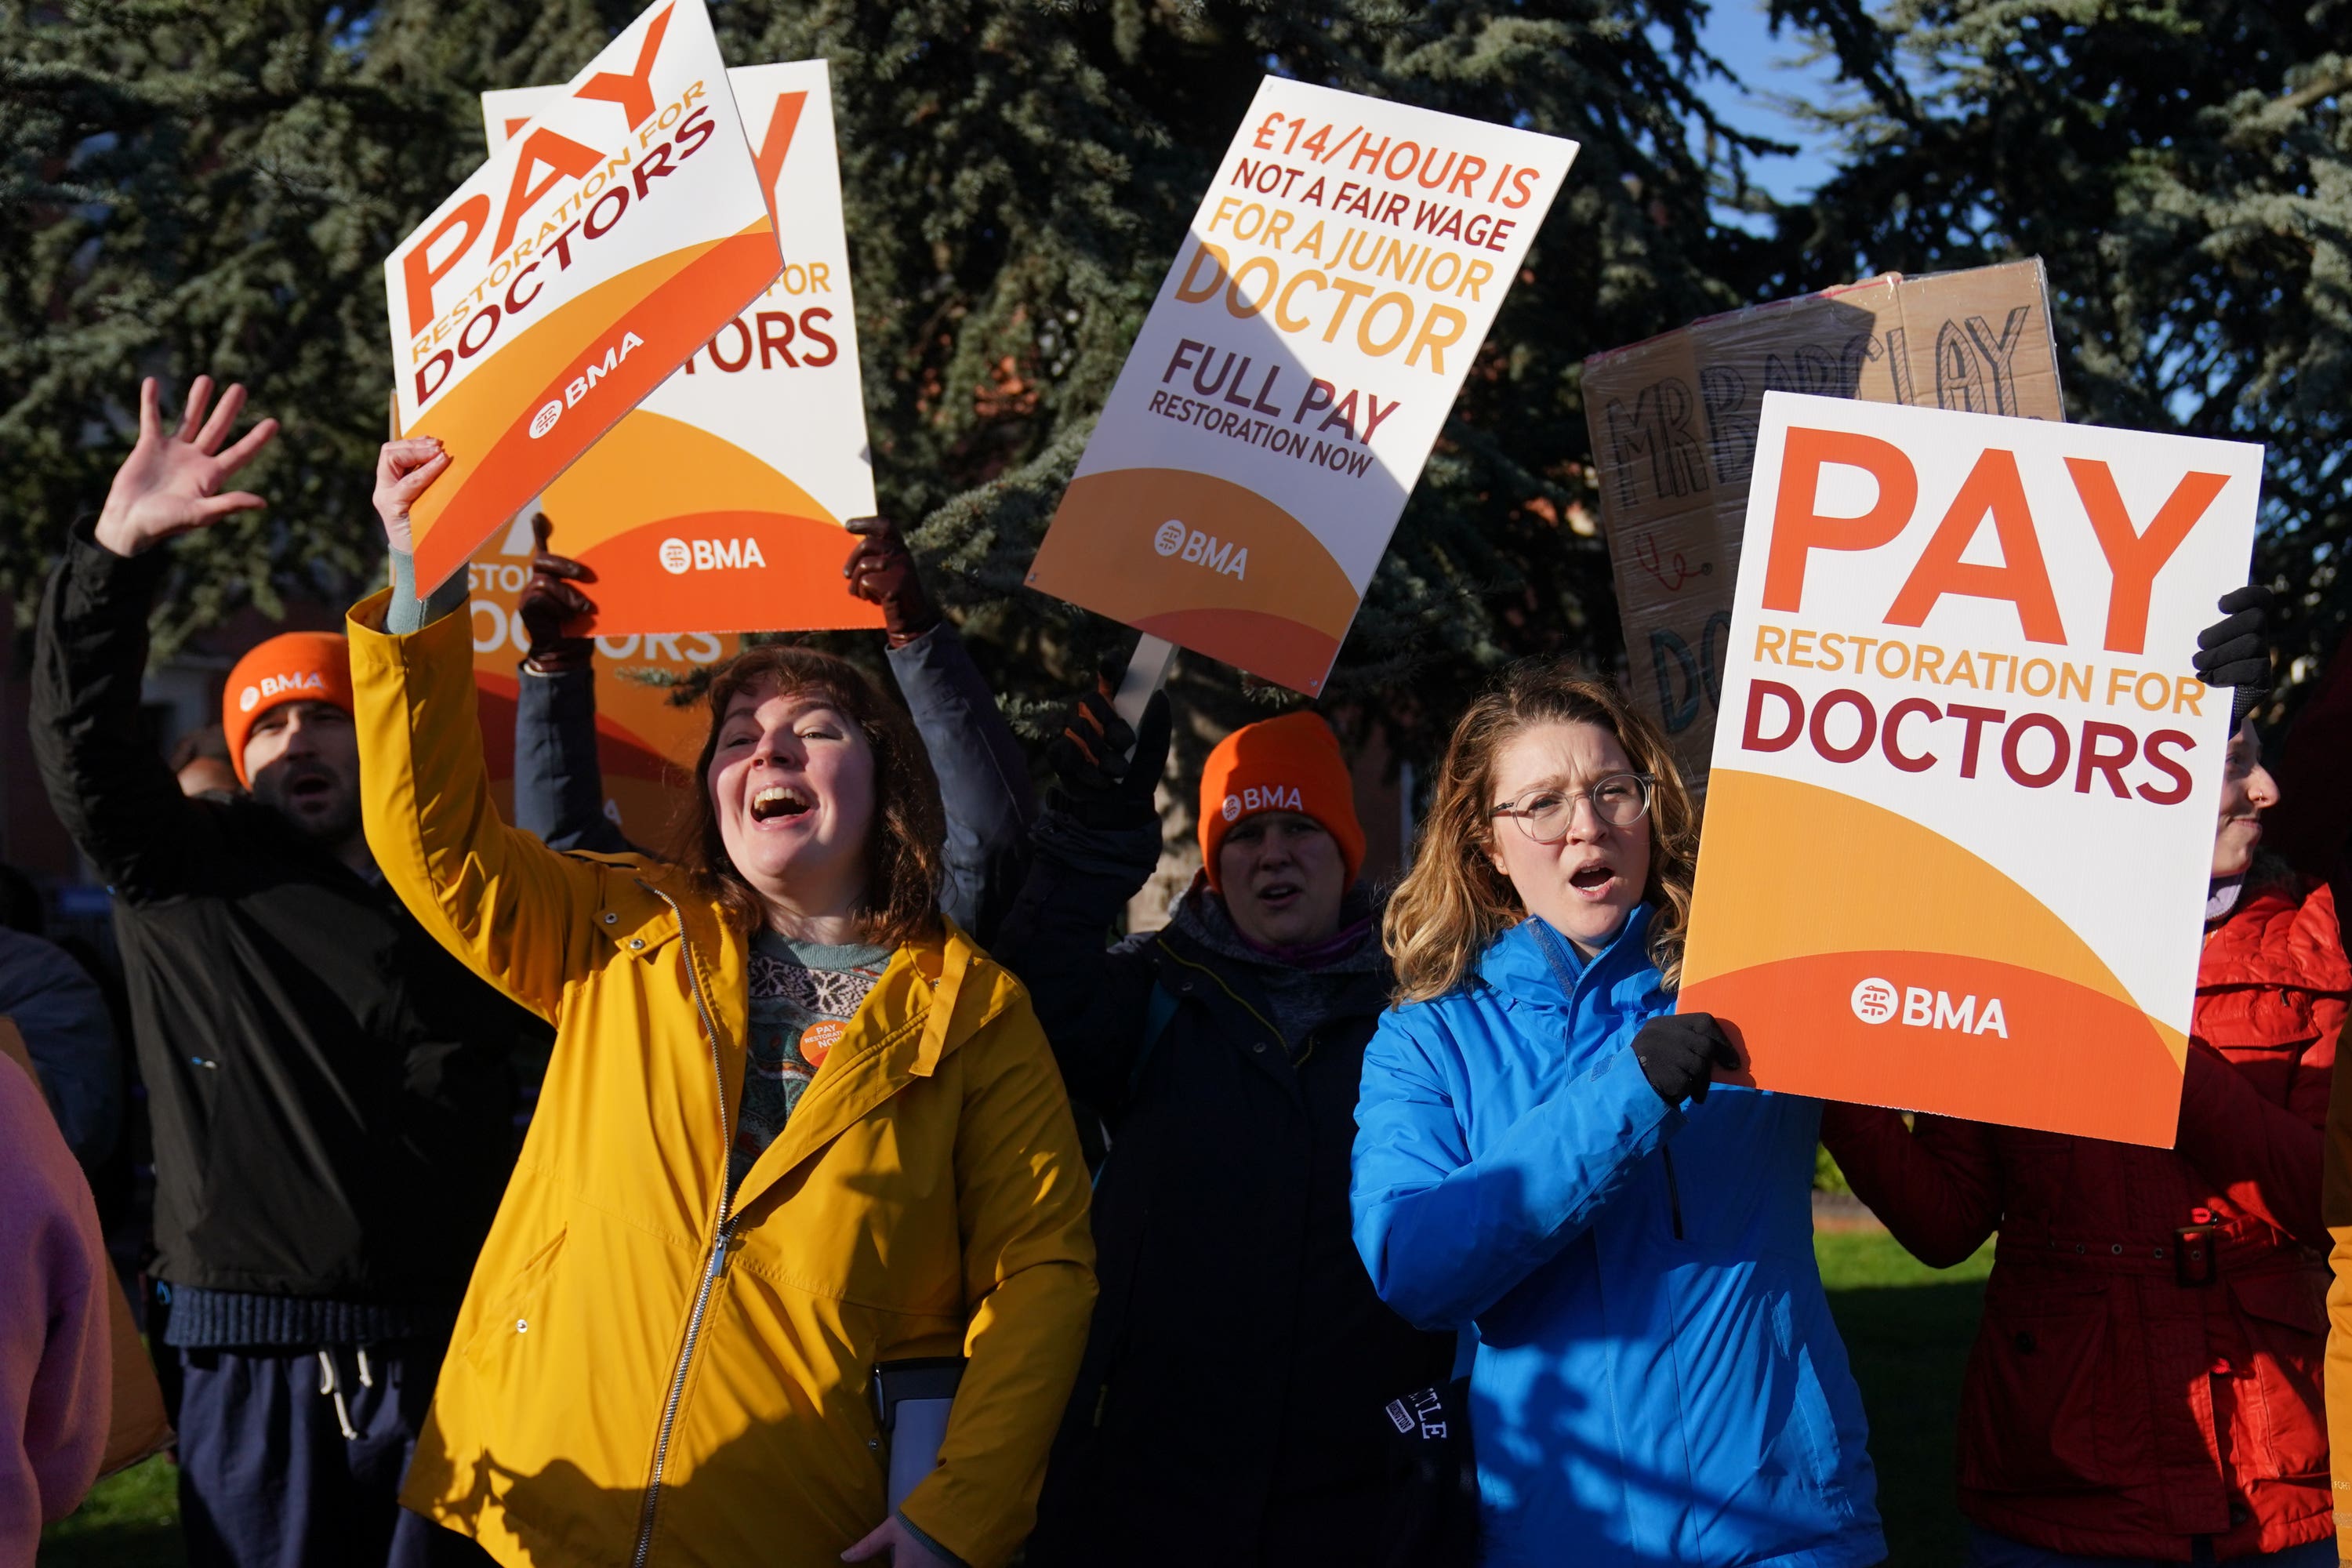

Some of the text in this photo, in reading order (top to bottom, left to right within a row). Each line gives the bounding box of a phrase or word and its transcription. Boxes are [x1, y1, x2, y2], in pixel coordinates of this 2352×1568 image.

[403, 0, 677, 339] PAY
[1231, 157, 1516, 252] NOT A FAIR WAGE
[1254, 112, 1540, 209] £14/HOUR IS
[412, 148, 632, 365] RESTORATION
[639, 80, 707, 151] FOR
[415, 105, 715, 408] DOCTORS
[1208, 196, 1494, 301] FOR A JUNIOR
[1174, 242, 1467, 375] DOCTOR
[564, 331, 644, 409] BMA
[1161, 339, 1401, 447] FULL PAY
[1148, 390, 1374, 478] RESTORATION NOW
[1608, 377, 1710, 508] MR
[694, 538, 766, 571] BMA
[1182, 530, 1248, 580] BMA
[1762, 426, 2231, 655] PAY
[260, 672, 325, 697] BMA
[1754, 625, 2205, 716] RESTORATION FOR
[1741, 679, 2198, 804] DOCTORS
[1243, 786, 1303, 811] BMA
[816, 1024, 836, 1034] PAY
[1903, 987, 2008, 1039] BMA
